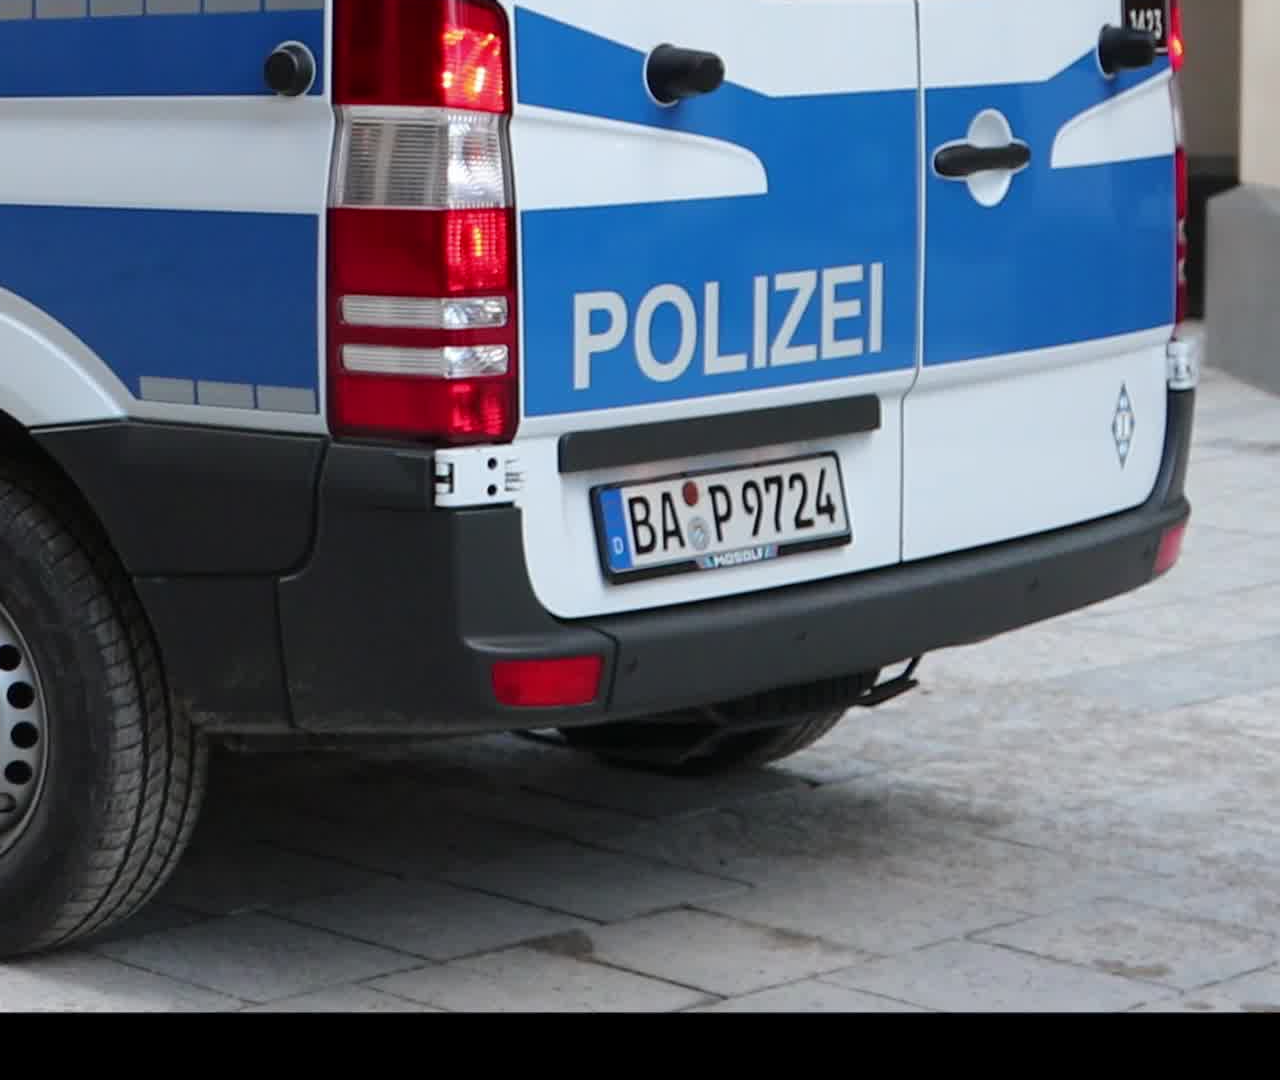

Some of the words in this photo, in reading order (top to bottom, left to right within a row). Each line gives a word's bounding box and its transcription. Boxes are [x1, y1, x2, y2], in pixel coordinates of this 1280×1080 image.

[573, 262, 884, 390] POLIZEI
[612, 537, 624, 556] D
[628, 495, 686, 555] BA
[707, 484, 732, 543] P
[742, 468, 836, 537] 9724
